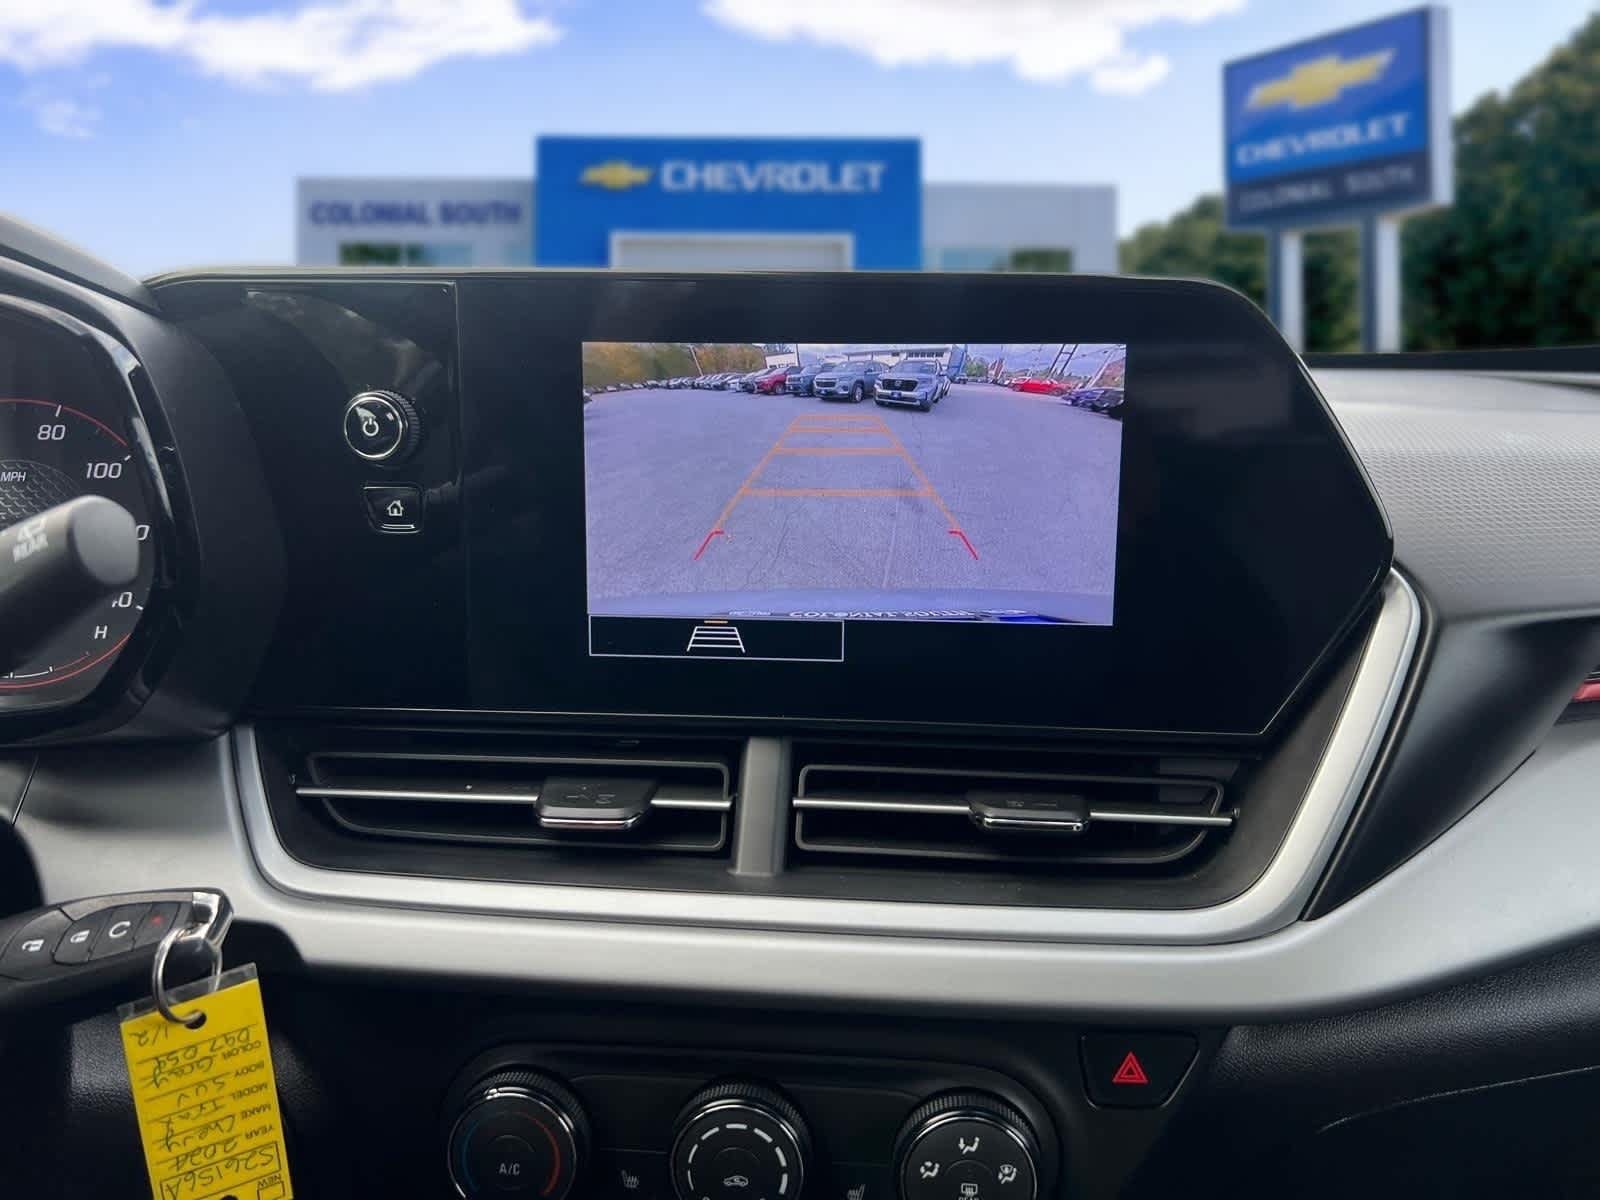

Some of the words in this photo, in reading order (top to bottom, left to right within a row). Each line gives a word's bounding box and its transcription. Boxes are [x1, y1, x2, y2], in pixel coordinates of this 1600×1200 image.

[1235, 112, 1411, 167] CHEVROLET
[660, 159, 887, 193] CHEVROLET
[309, 198, 432, 227] COLONIAL
[438, 198, 522, 227] SOUTH
[37, 424, 66, 441] 80
[1, 471, 27, 482] MPH
[86, 462, 122, 480] 100
[94, 625, 108, 639] H
[222, 1040, 262, 1060] COLOR
[234, 1062, 265, 1078] BODY
[232, 1083, 268, 1101] MODEL
[241, 1104, 271, 1120] MAKE
[245, 1125, 275, 1139] YEAR
[498, 1162, 521, 1175] A/C
[257, 1173, 282, 1190] NEW
